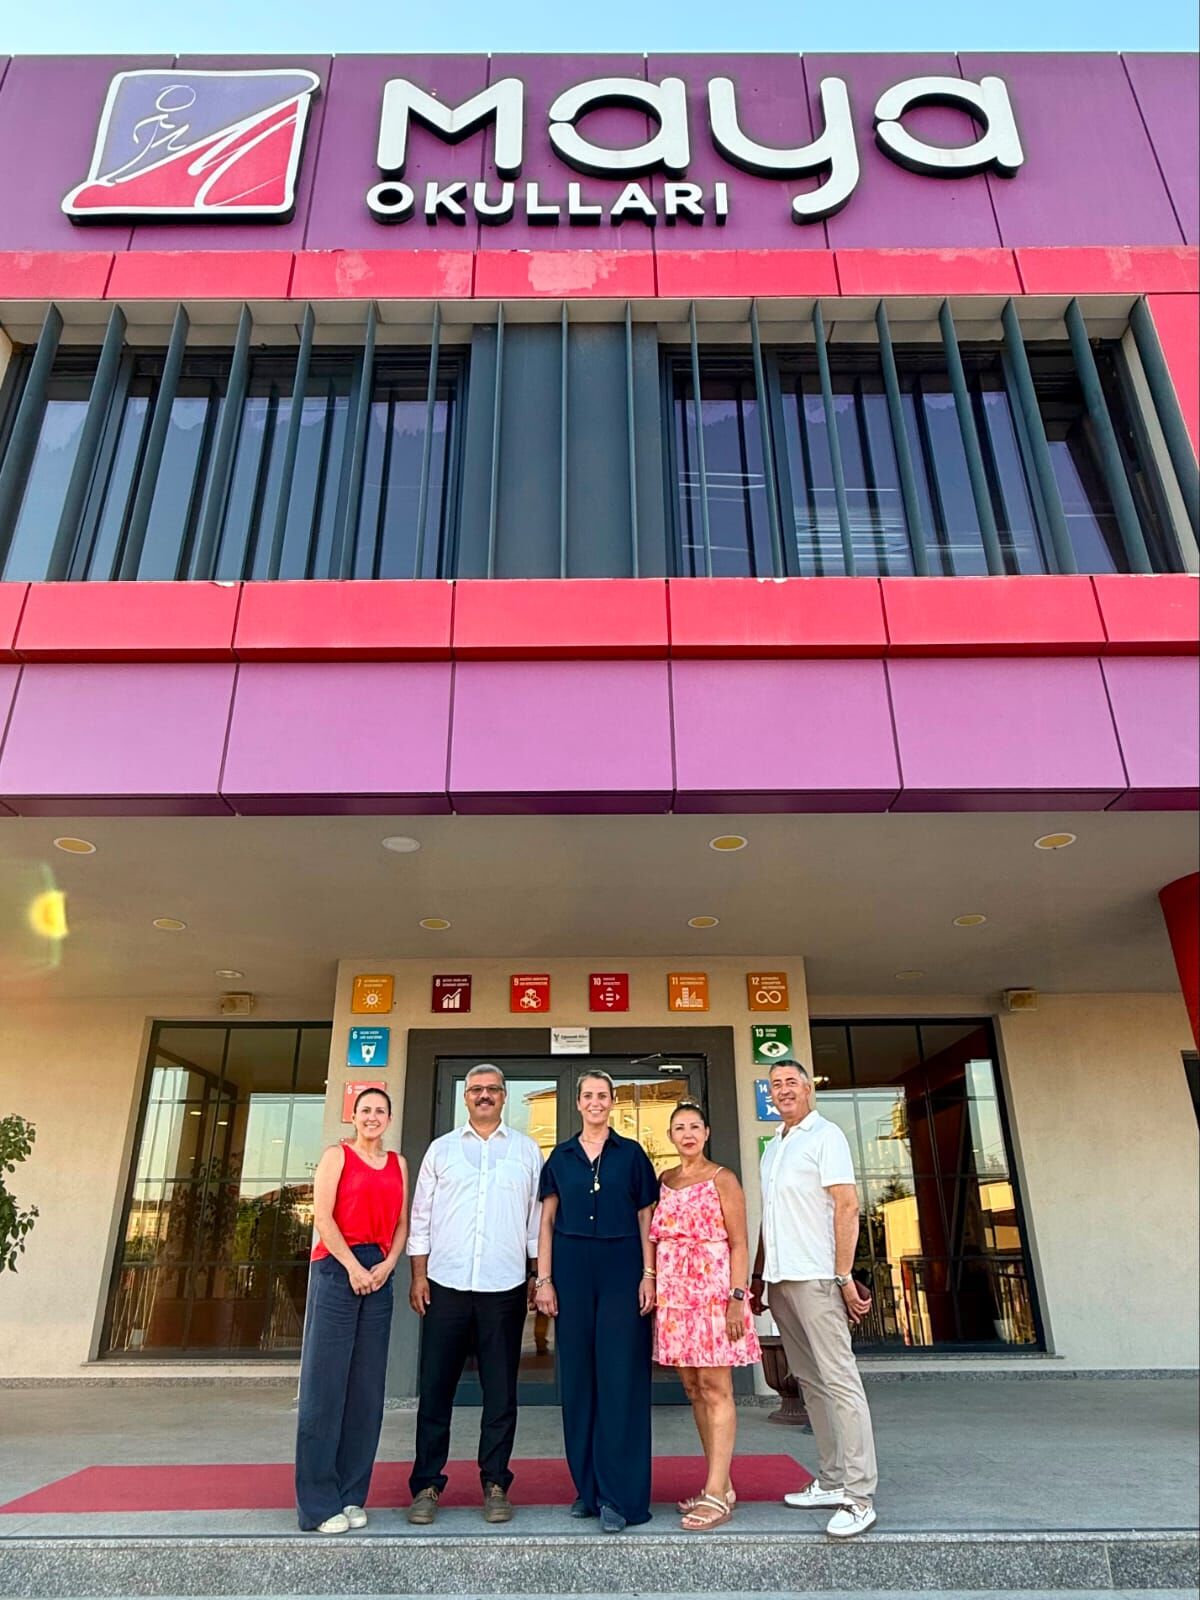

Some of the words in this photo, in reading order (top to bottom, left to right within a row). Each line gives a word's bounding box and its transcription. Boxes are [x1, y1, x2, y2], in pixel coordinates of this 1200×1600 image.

[376, 75, 1024, 218] Maya
[366, 181, 729, 220] OKULLARI
[357, 979, 362, 988] 7
[435, 979, 441, 987] 8
[513, 978, 519, 986] 9
[593, 977, 601, 986] 10
[672, 976, 679, 985] 11
[751, 977, 760, 985] 12
[352, 1031, 358, 1040] 6
[755, 1028, 764, 1037] 13
[347, 1085, 353, 1094] 5
[759, 1084, 768, 1093] 14
